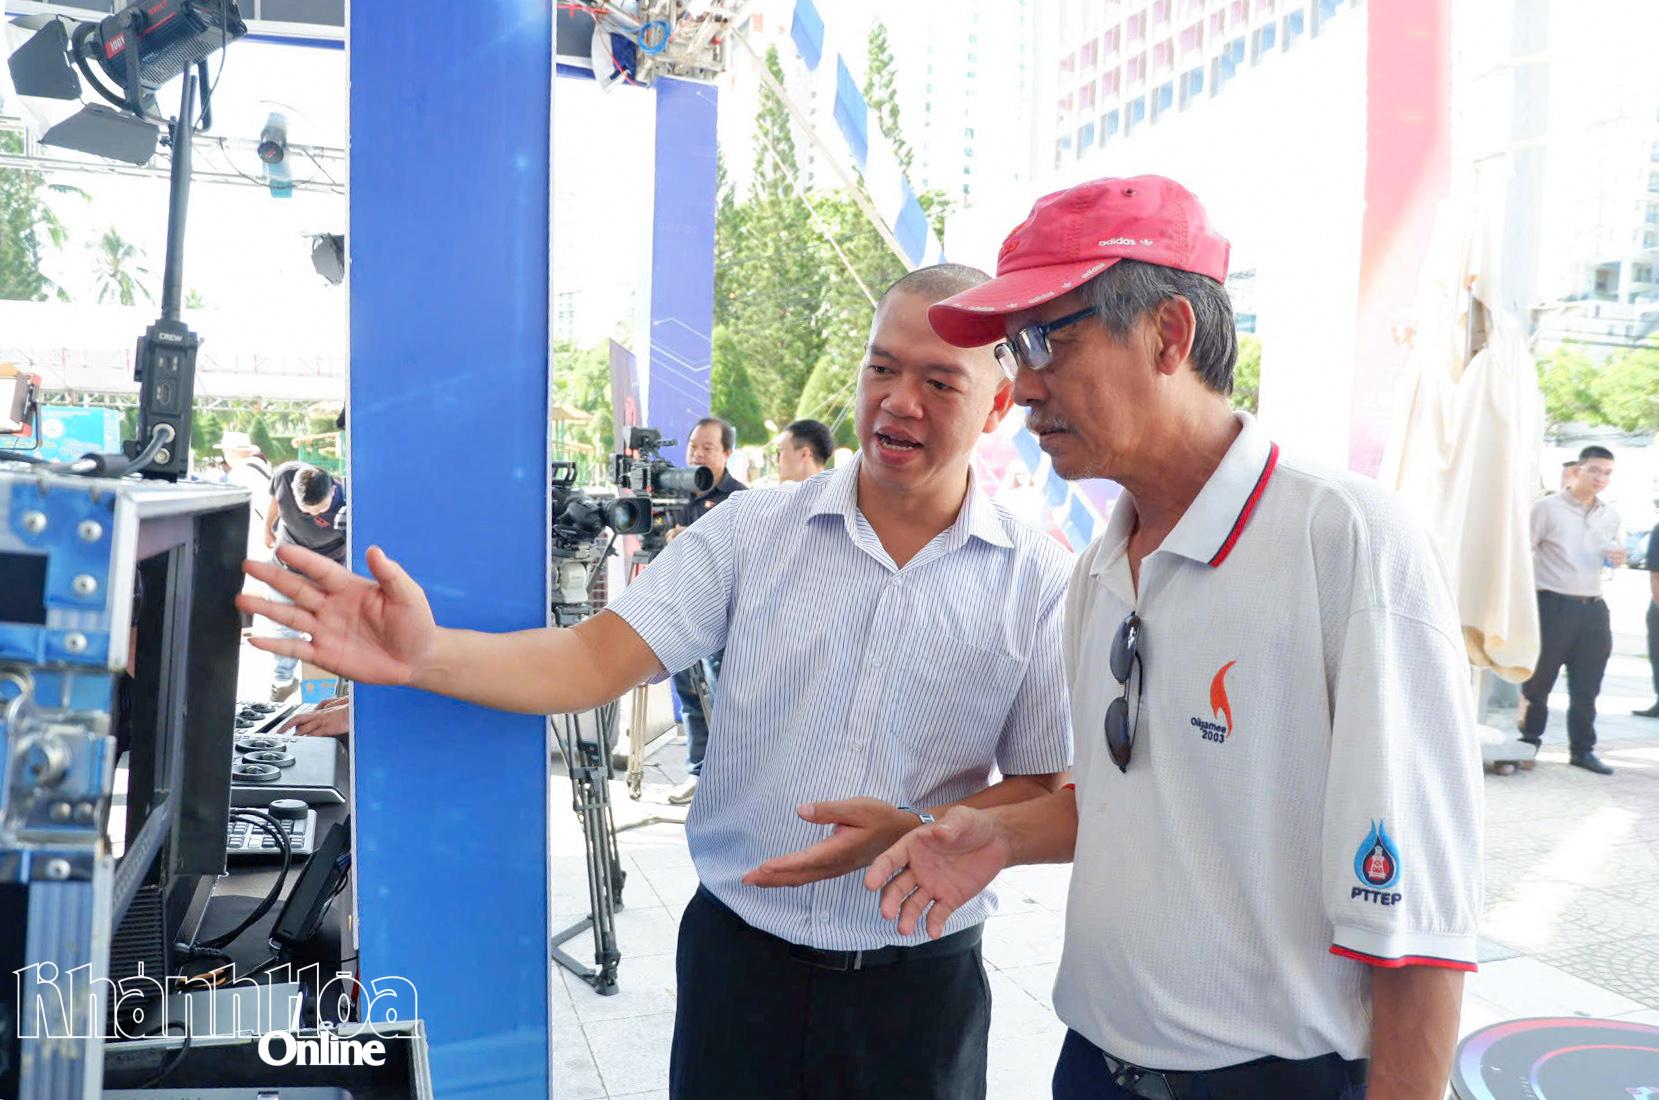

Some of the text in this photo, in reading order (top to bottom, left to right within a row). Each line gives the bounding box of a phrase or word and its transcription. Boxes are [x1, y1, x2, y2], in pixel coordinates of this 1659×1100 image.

[1098, 237, 1136, 246] adidas
[1201, 730, 1225, 743] 2003
[1351, 887, 1402, 905] PTTEP
